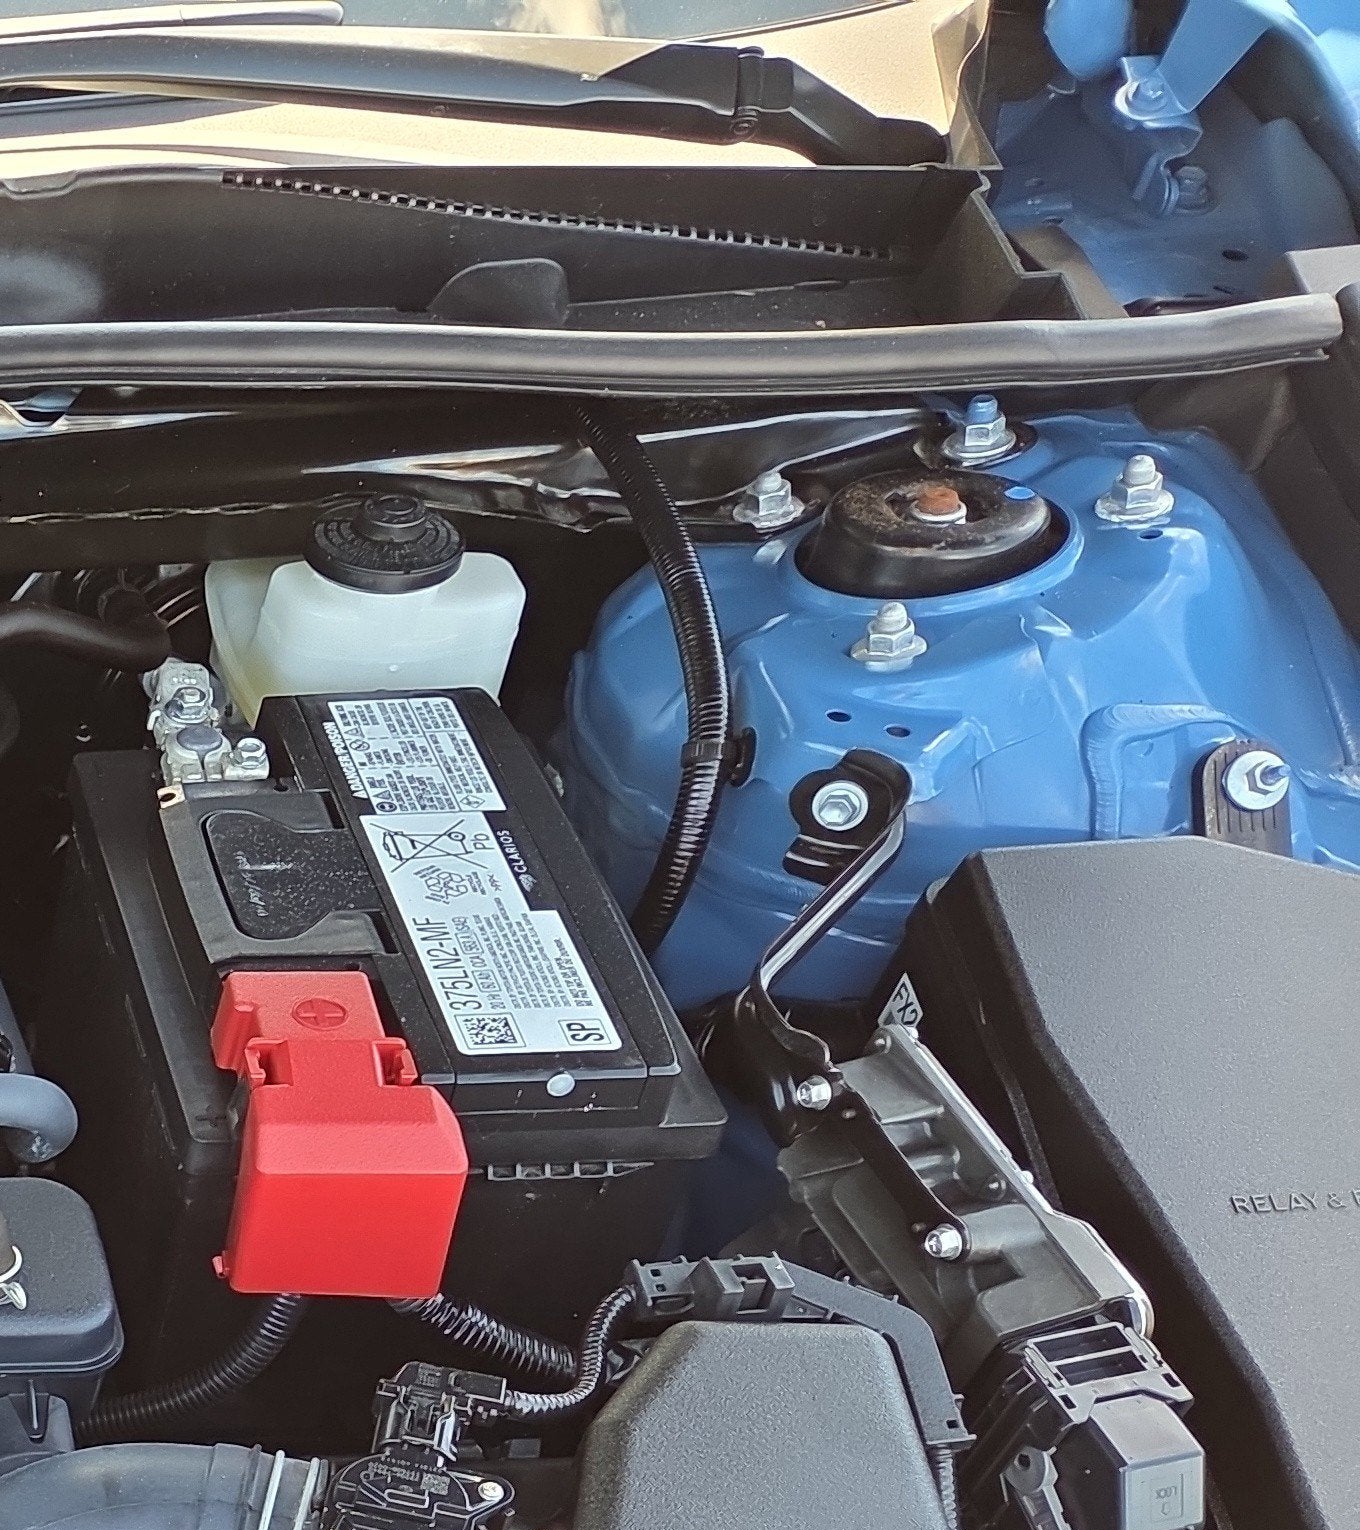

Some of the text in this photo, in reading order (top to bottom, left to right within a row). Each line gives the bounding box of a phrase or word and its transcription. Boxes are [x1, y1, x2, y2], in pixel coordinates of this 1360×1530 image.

[470, 833, 494, 850] Pb
[497, 830, 527, 873] CLARIOS
[412, 917, 482, 1010] 375LN2-MF
[566, 1022, 605, 1042] SP
[1229, 1192, 1318, 1214] RELAY
[1326, 1192, 1347, 1209] &
